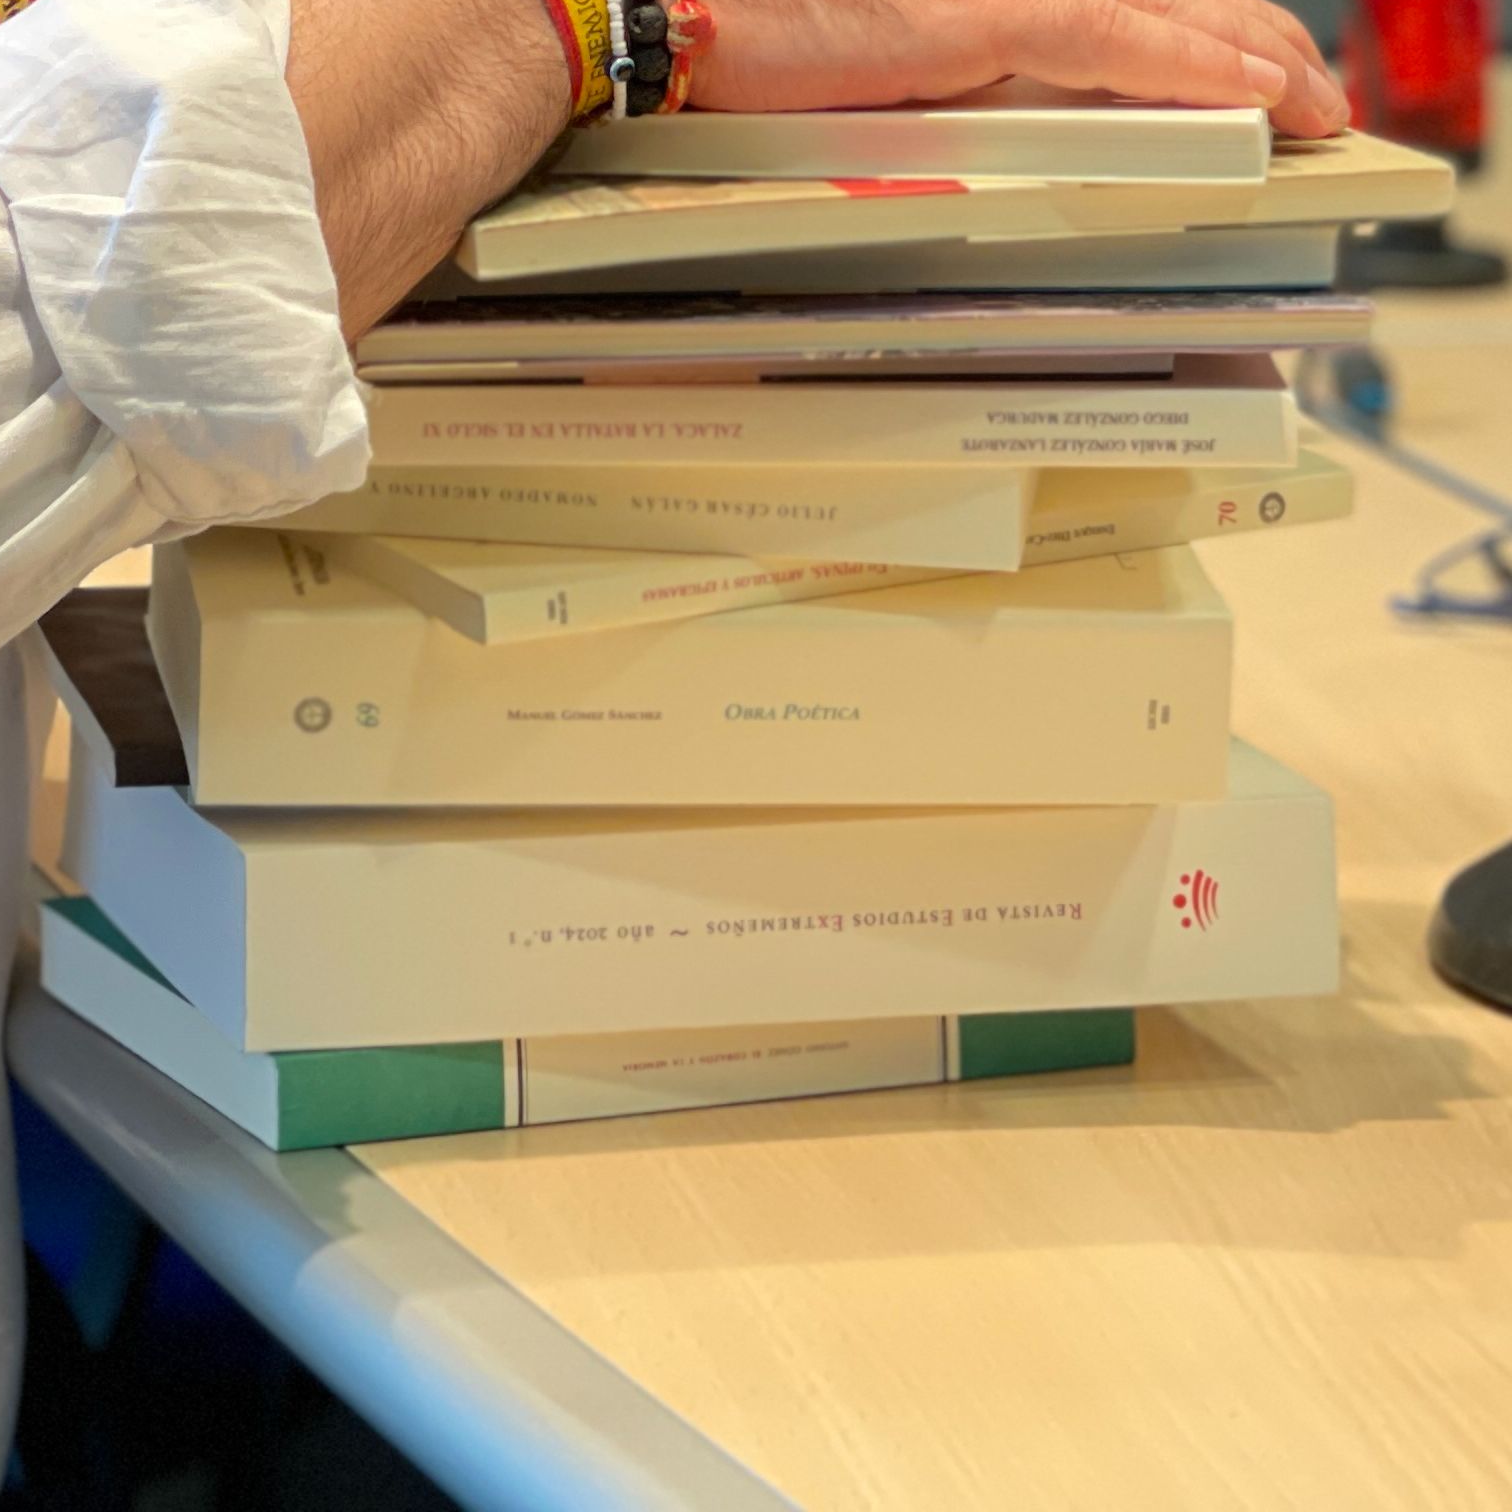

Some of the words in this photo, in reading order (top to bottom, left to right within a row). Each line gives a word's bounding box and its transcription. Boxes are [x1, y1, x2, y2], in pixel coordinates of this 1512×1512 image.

[985, 411, 1059, 426] MADURGA
[1063, 411, 1139, 428] GONZÁLEZ
[1143, 411, 1190, 426] DIEGO
[422, 422, 442, 440] XI
[446, 422, 499, 440] SIGLO
[507, 422, 526, 440] EL
[530, 422, 554, 440] EN
[560, 422, 637, 440] BATALLA
[642, 422, 666, 440] LA
[960, 438, 1046, 452] LANZAROTE
[1050, 438, 1126, 455] GONZÁLEZ
[1130, 438, 1177, 455] MARÍA
[1182, 438, 1216, 456] JOSÉ
[387, 482, 490, 502] ARGELINO
[498, 487, 598, 508] NOMADEO
[630, 496, 699, 513] GALÁN
[706, 500, 770, 520] CÉSAR
[776, 504, 838, 522] JULIO
[1218, 500, 1238, 528] 70
[558, 924, 608, 944] 2024,
[615, 926, 656, 944] año
